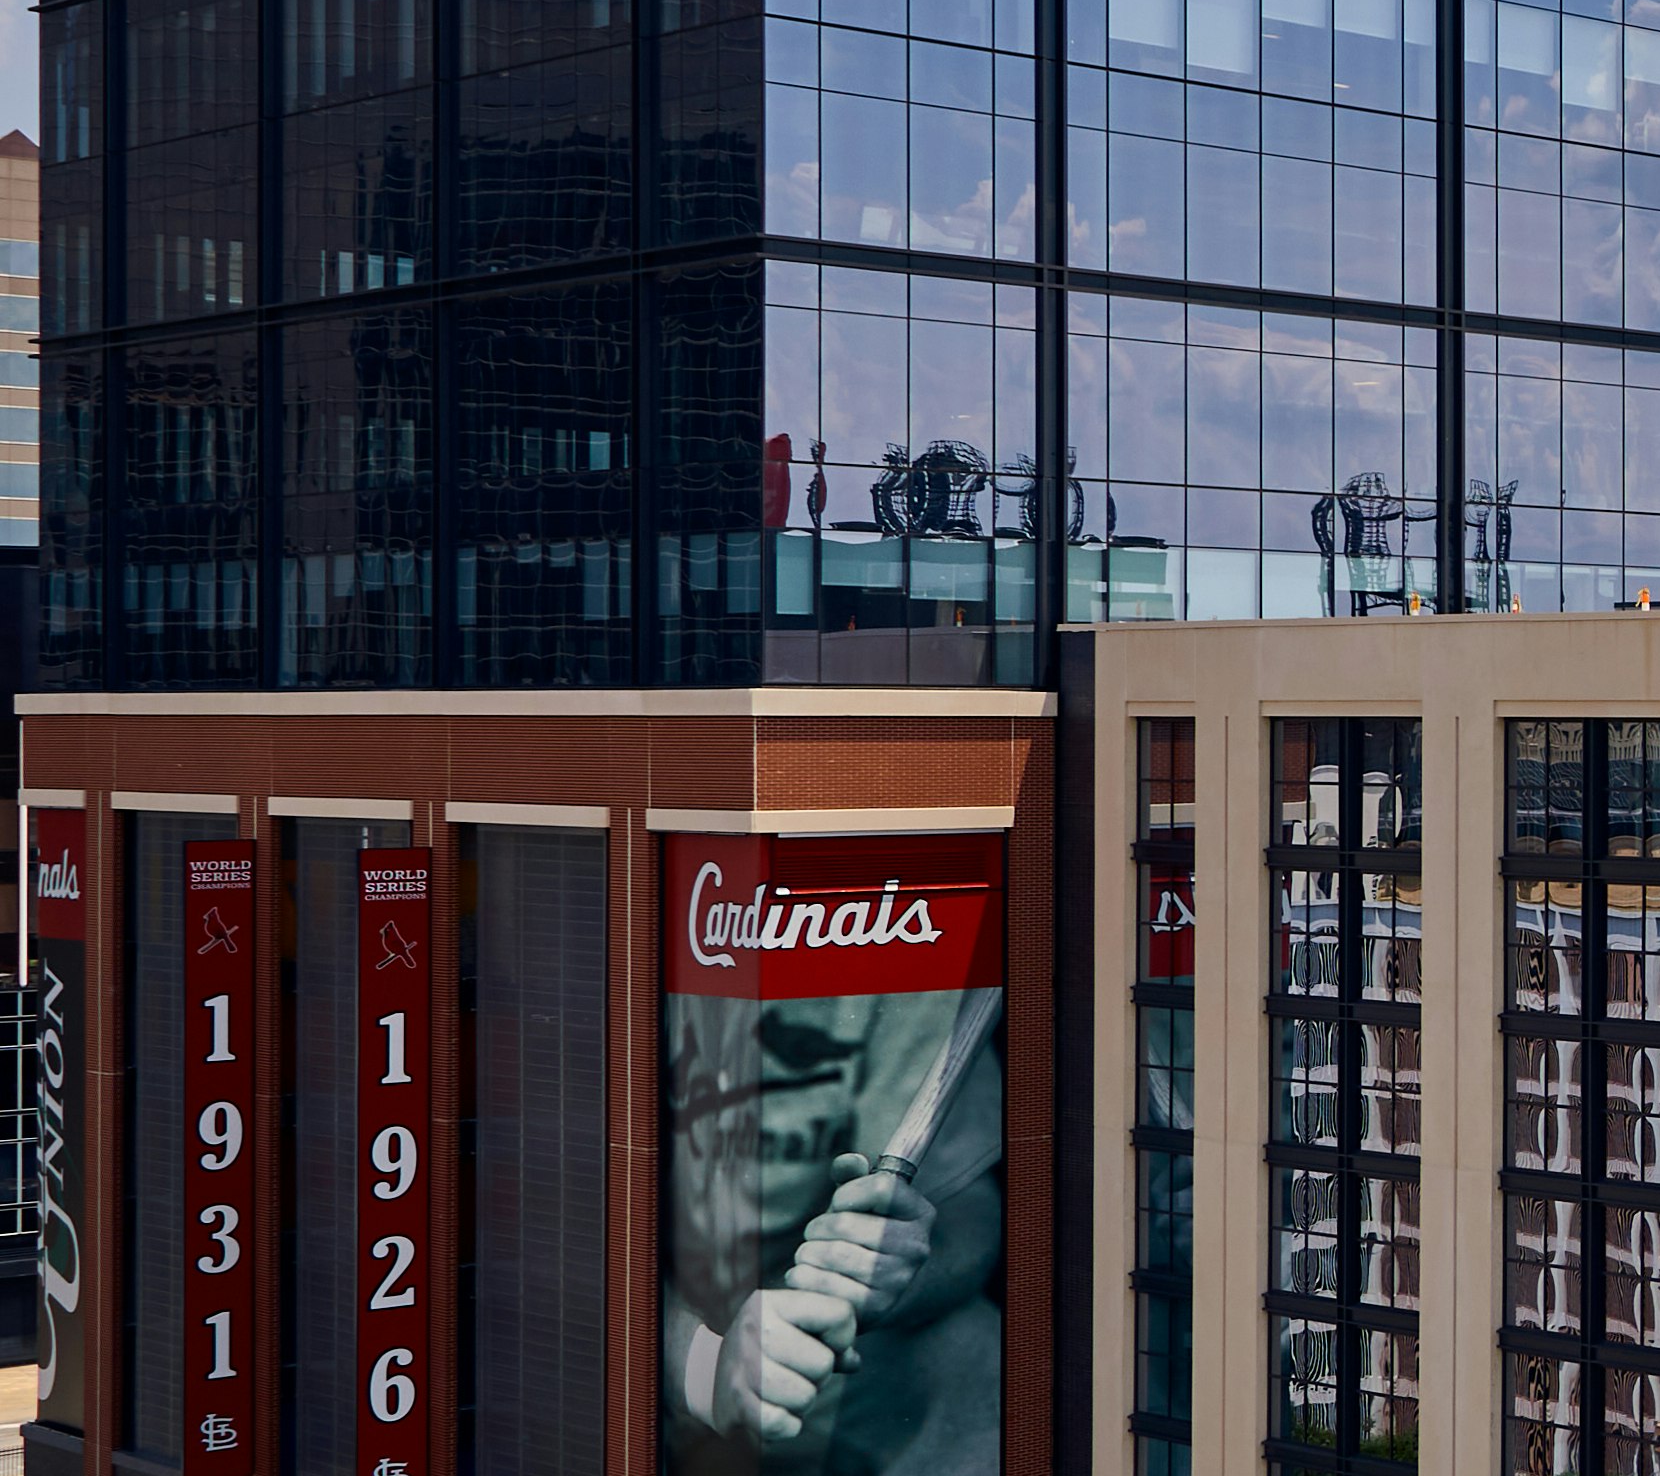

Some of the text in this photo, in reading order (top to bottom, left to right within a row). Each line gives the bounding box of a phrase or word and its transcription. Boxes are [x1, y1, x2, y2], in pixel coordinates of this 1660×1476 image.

[190, 860, 251, 871] WORLD
[191, 871, 251, 883] SERIES
[363, 869, 427, 881] WORLD
[191, 882, 251, 890] CHAMPIONS
[364, 881, 427, 893] SERIES
[364, 893, 427, 901] CHAMPIONS
[688, 861, 943, 968] Cardinals
[197, 993, 243, 1381] 1931
[367, 1010, 418, 1423] 1926
